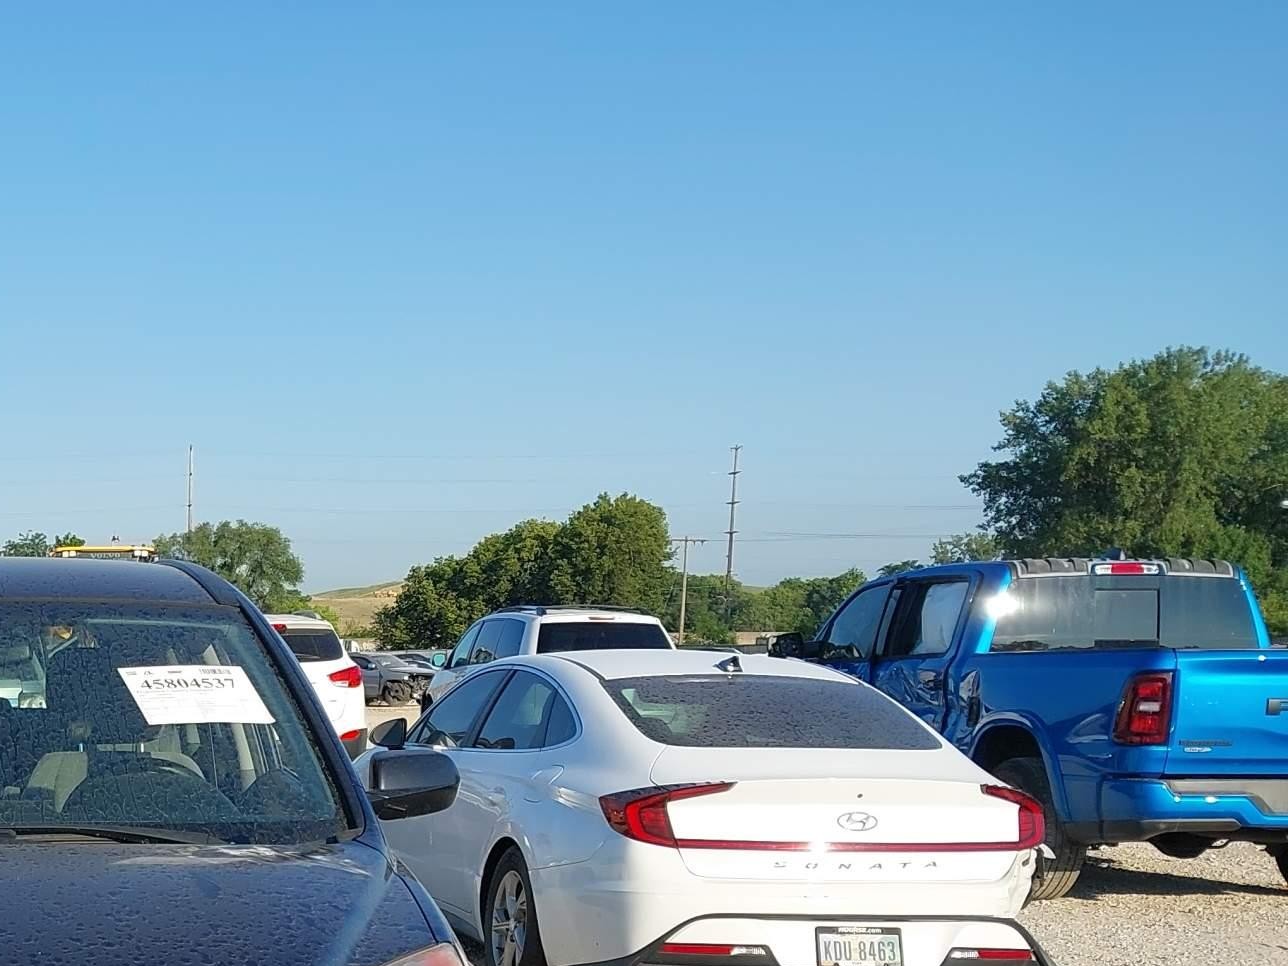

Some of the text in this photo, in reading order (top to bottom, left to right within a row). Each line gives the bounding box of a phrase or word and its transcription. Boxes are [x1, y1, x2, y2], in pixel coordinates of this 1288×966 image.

[140, 678, 235, 690] 45804537
[773, 861, 938, 870] SONATA
[823, 941, 896, 961] KDU 8463
